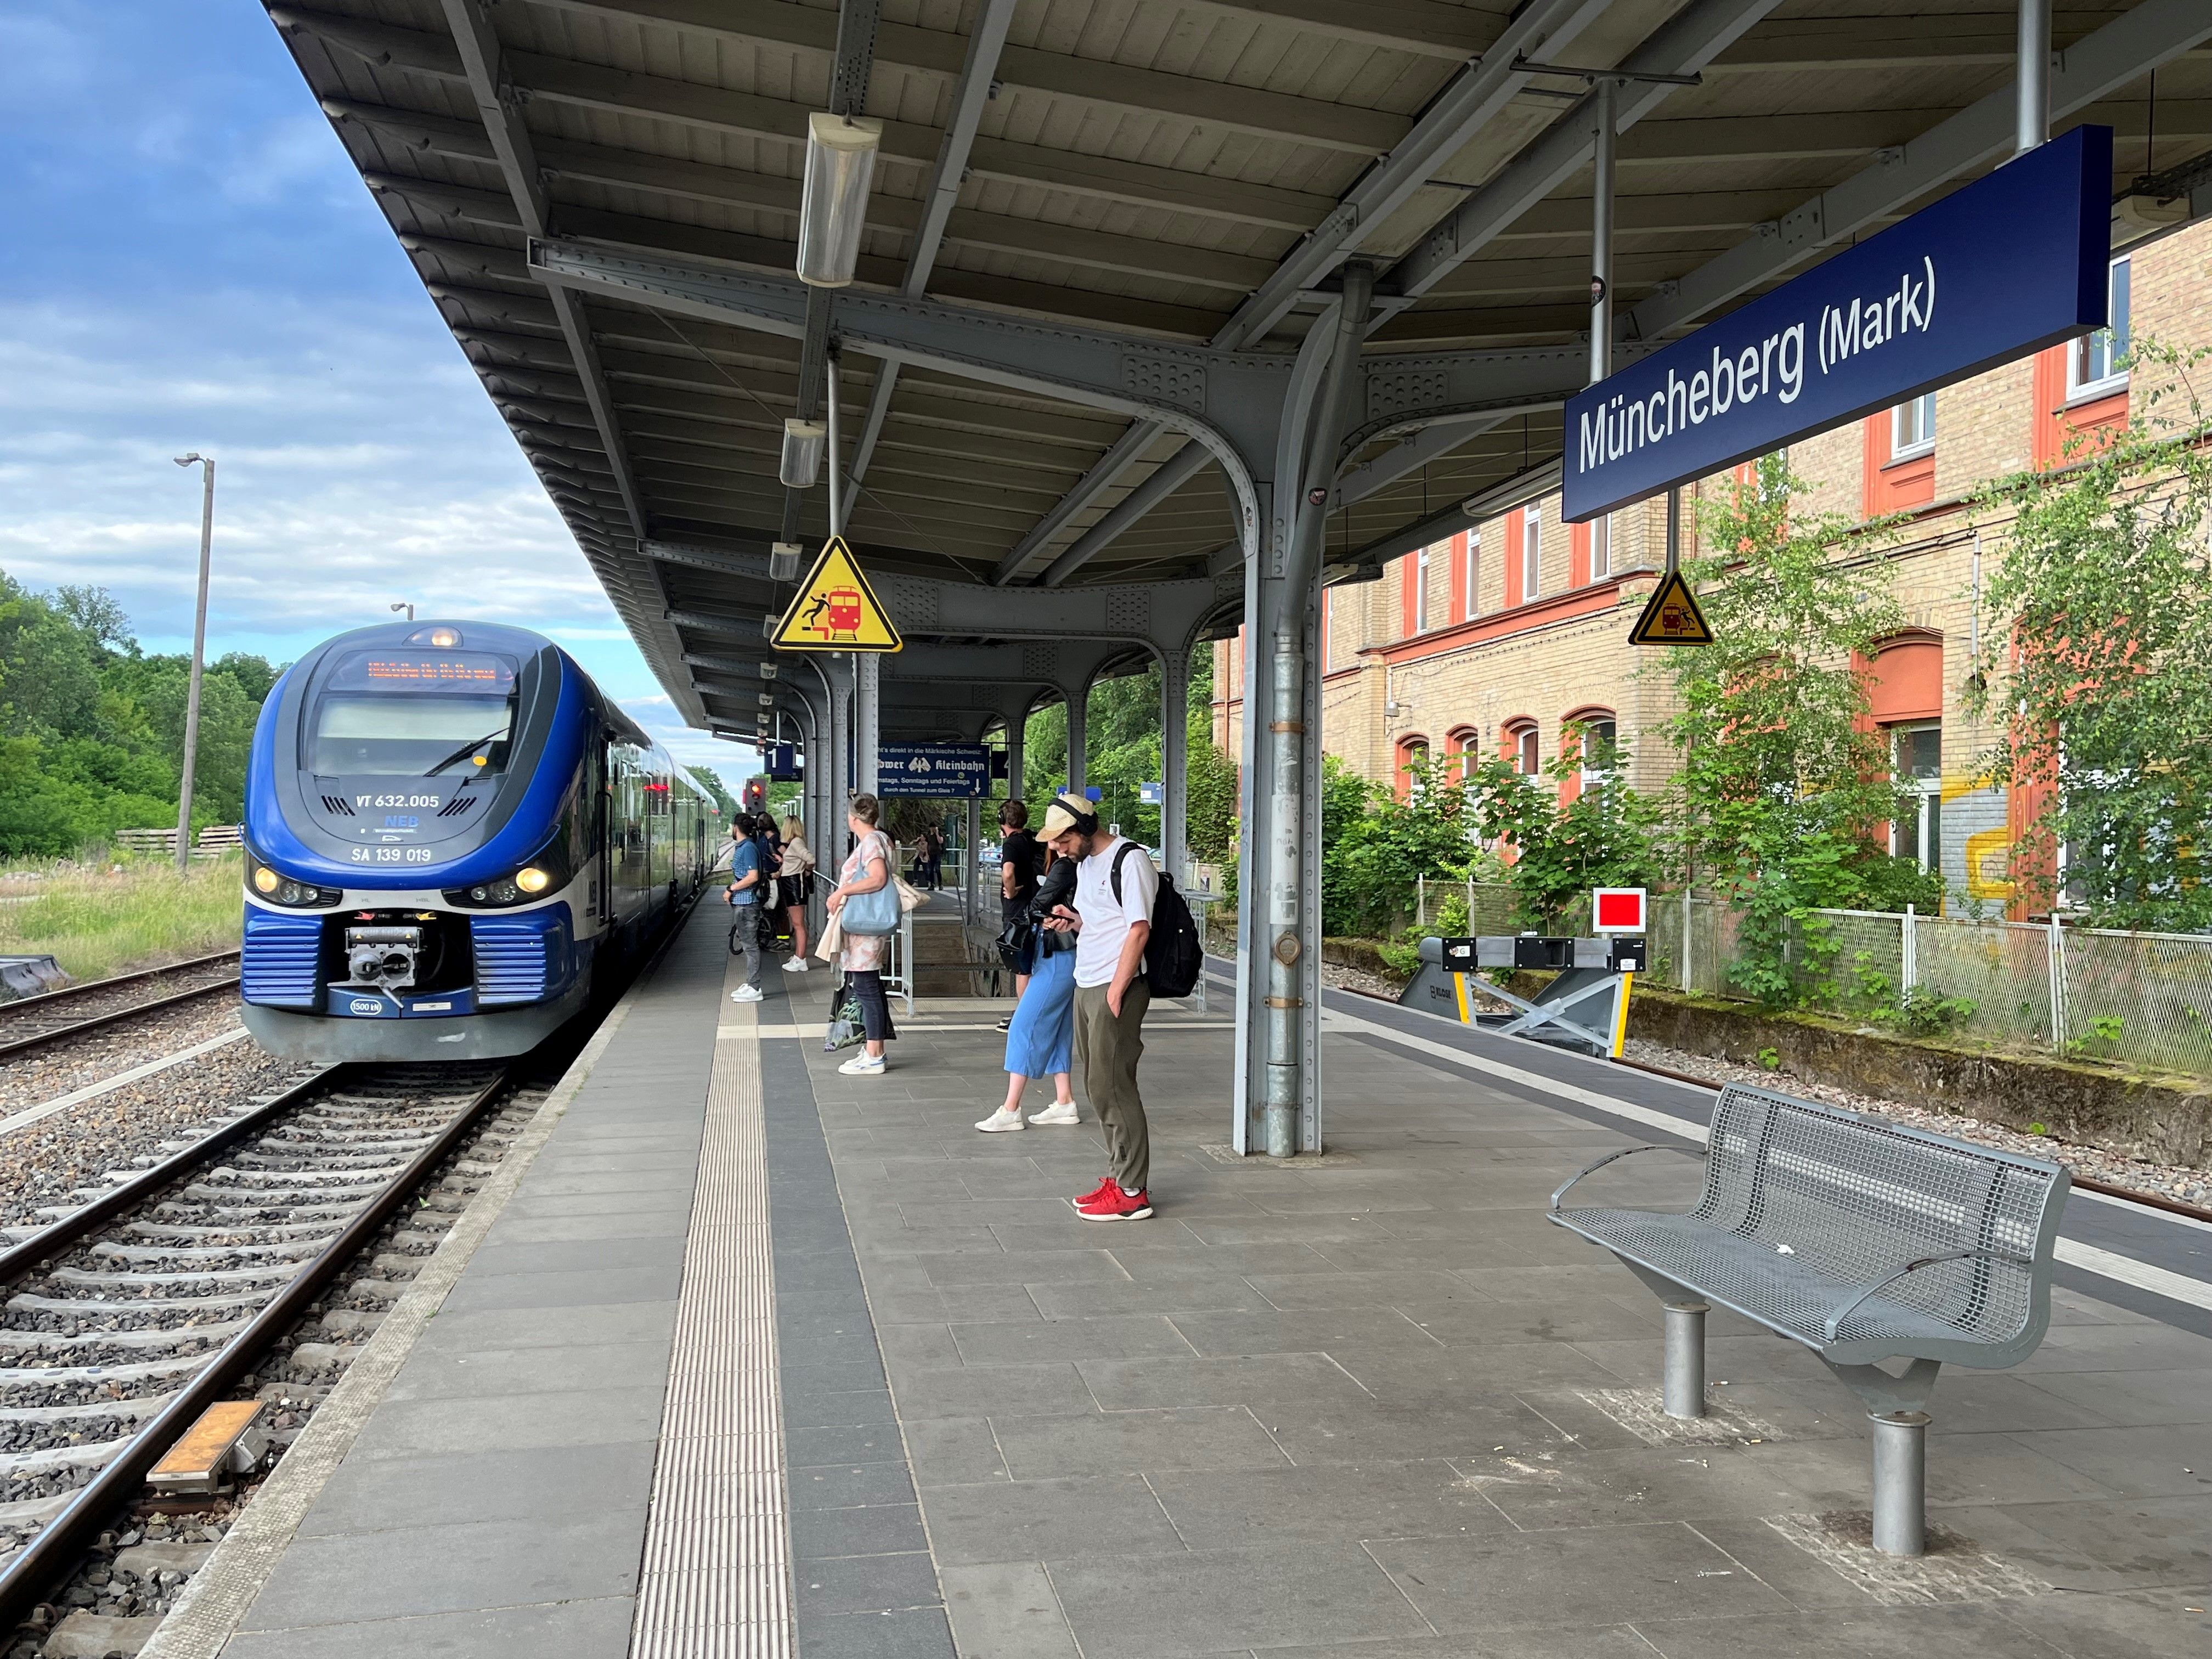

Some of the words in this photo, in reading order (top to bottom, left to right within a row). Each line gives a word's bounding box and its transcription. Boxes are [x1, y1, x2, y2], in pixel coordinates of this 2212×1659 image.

[1579, 323, 1804, 473] Müncheberg
[1819, 256, 1936, 374] (Mark)
[768, 748, 776, 768] 1
[878, 759, 904, 769] ower
[935, 760, 985, 772] Kleinbahn
[356, 795, 371, 807] VT
[375, 795, 439, 808] 632.005
[385, 815, 419, 827] NEB
[351, 849, 370, 861] SA
[376, 849, 400, 861] 139
[407, 849, 431, 862] 019
